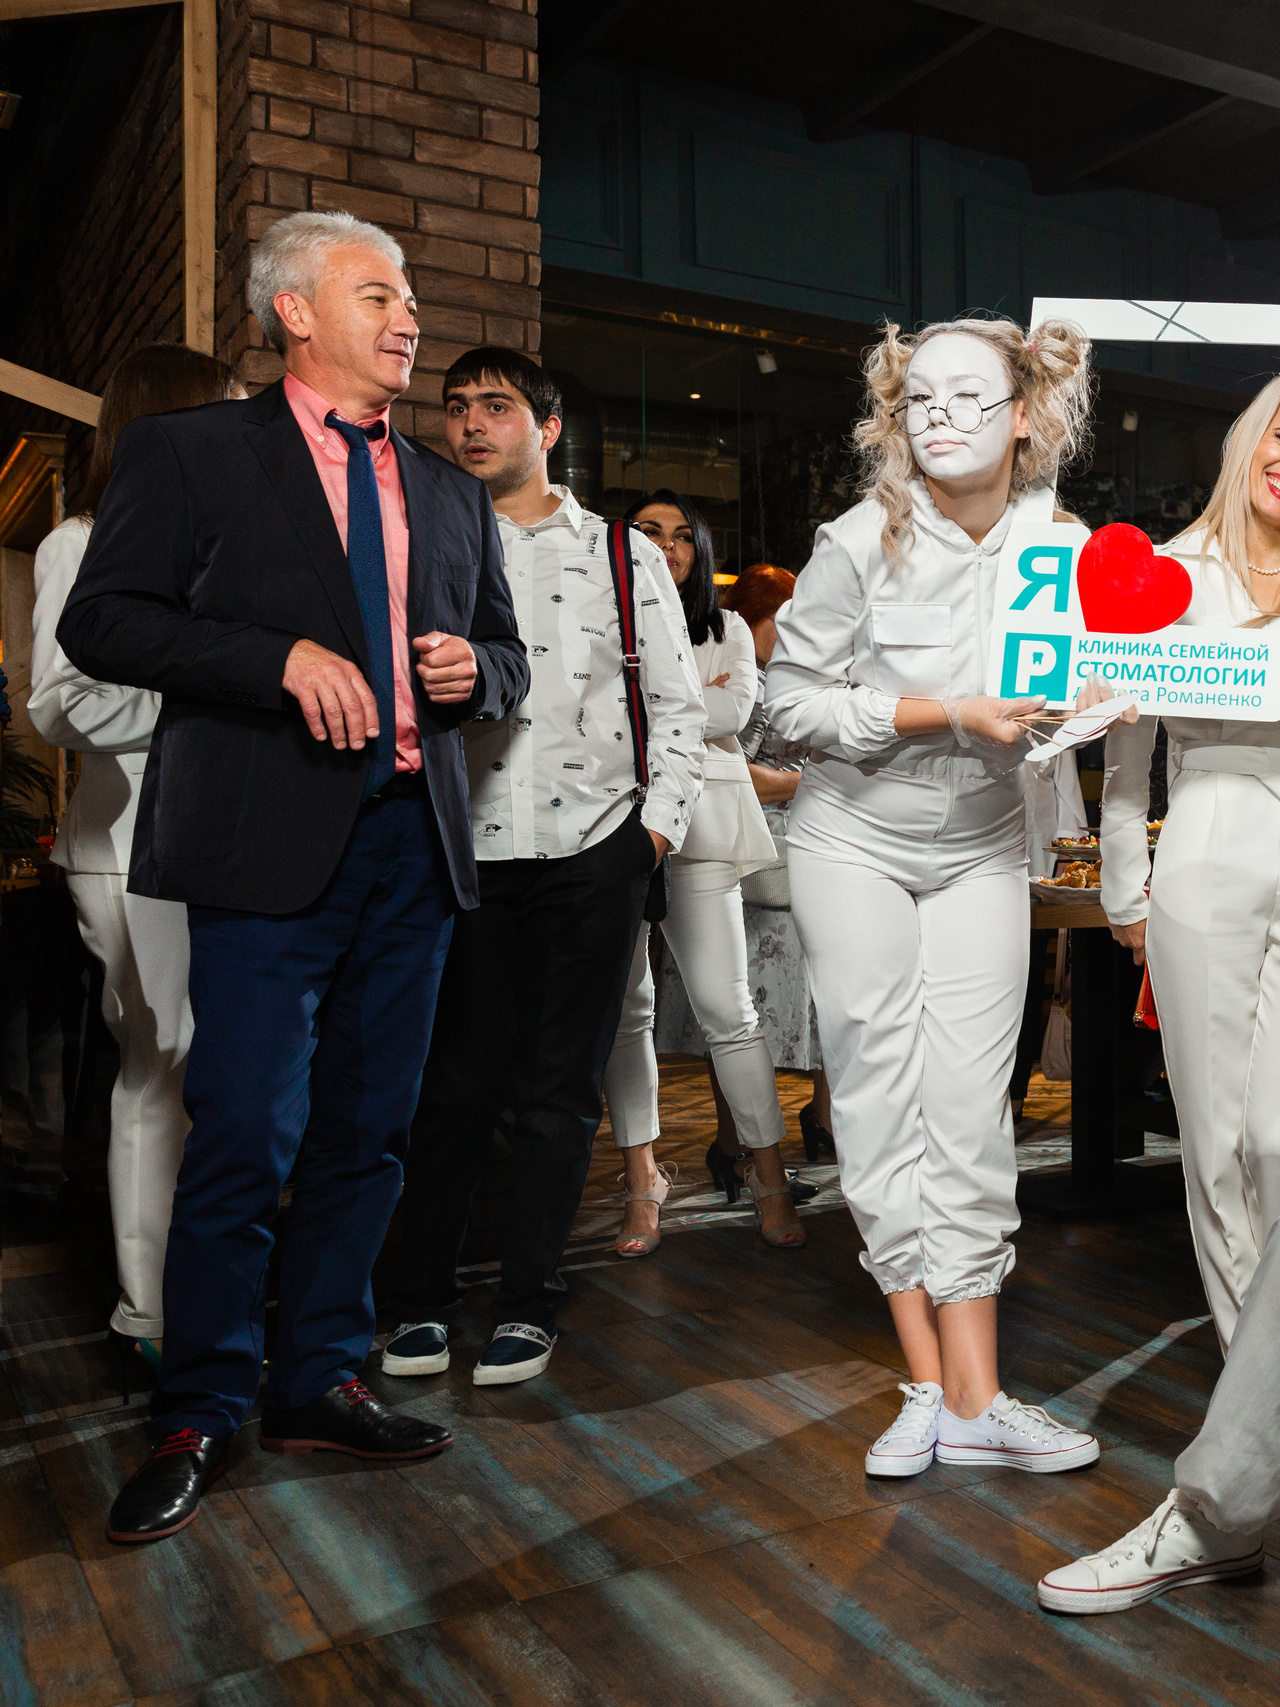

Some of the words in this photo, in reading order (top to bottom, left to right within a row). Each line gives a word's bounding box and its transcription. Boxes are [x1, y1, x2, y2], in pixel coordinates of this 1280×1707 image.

[1008, 545, 1074, 613] Я
[1078, 639, 1163, 657] КЛИНИКА
[1168, 642, 1269, 662] СЕМЕЙНОЙ
[1076, 660, 1266, 687] СТОМАТОЛОГИИ
[1156, 686, 1262, 708] Романенко
